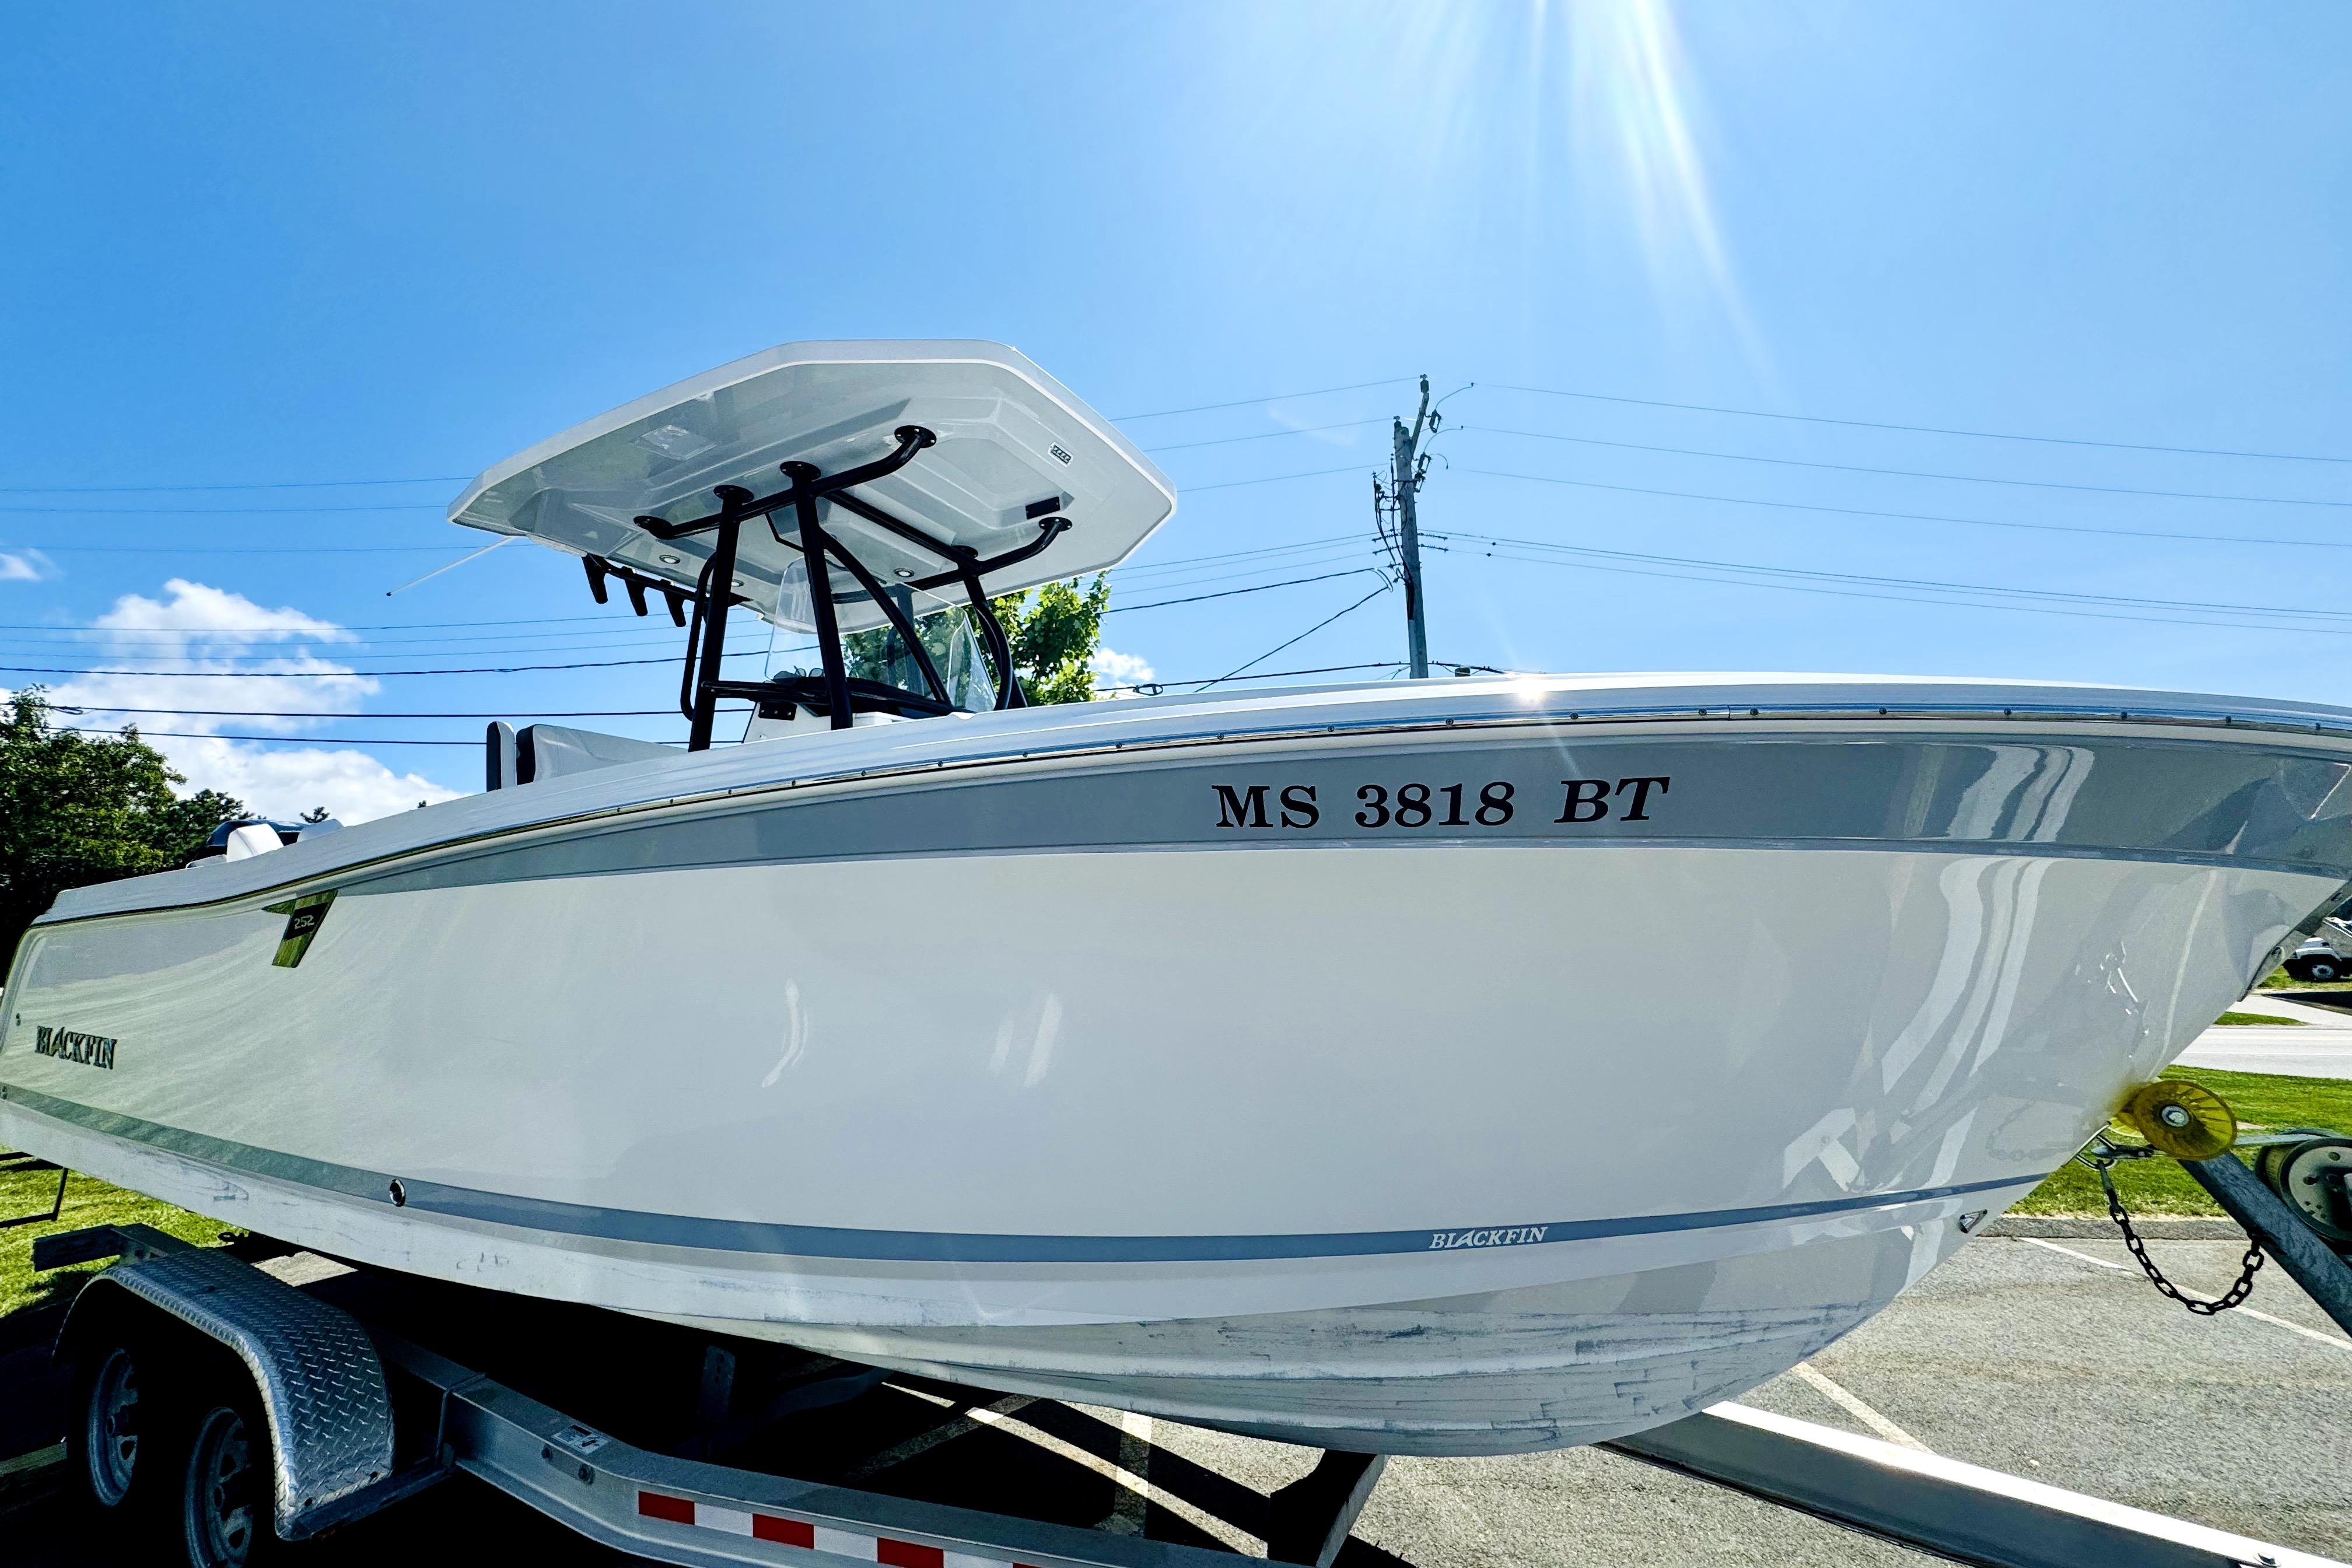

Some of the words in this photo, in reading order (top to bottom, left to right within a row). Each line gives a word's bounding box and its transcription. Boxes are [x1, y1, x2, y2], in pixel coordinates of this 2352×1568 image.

[1211, 783, 1320, 828] MS
[1354, 781, 1516, 828] 3818
[1553, 776, 1671, 824] BT
[294, 915, 315, 929] 252
[35, 1026, 118, 1070] BLACKFIN
[1429, 1226, 1548, 1249] BLACKFIN
